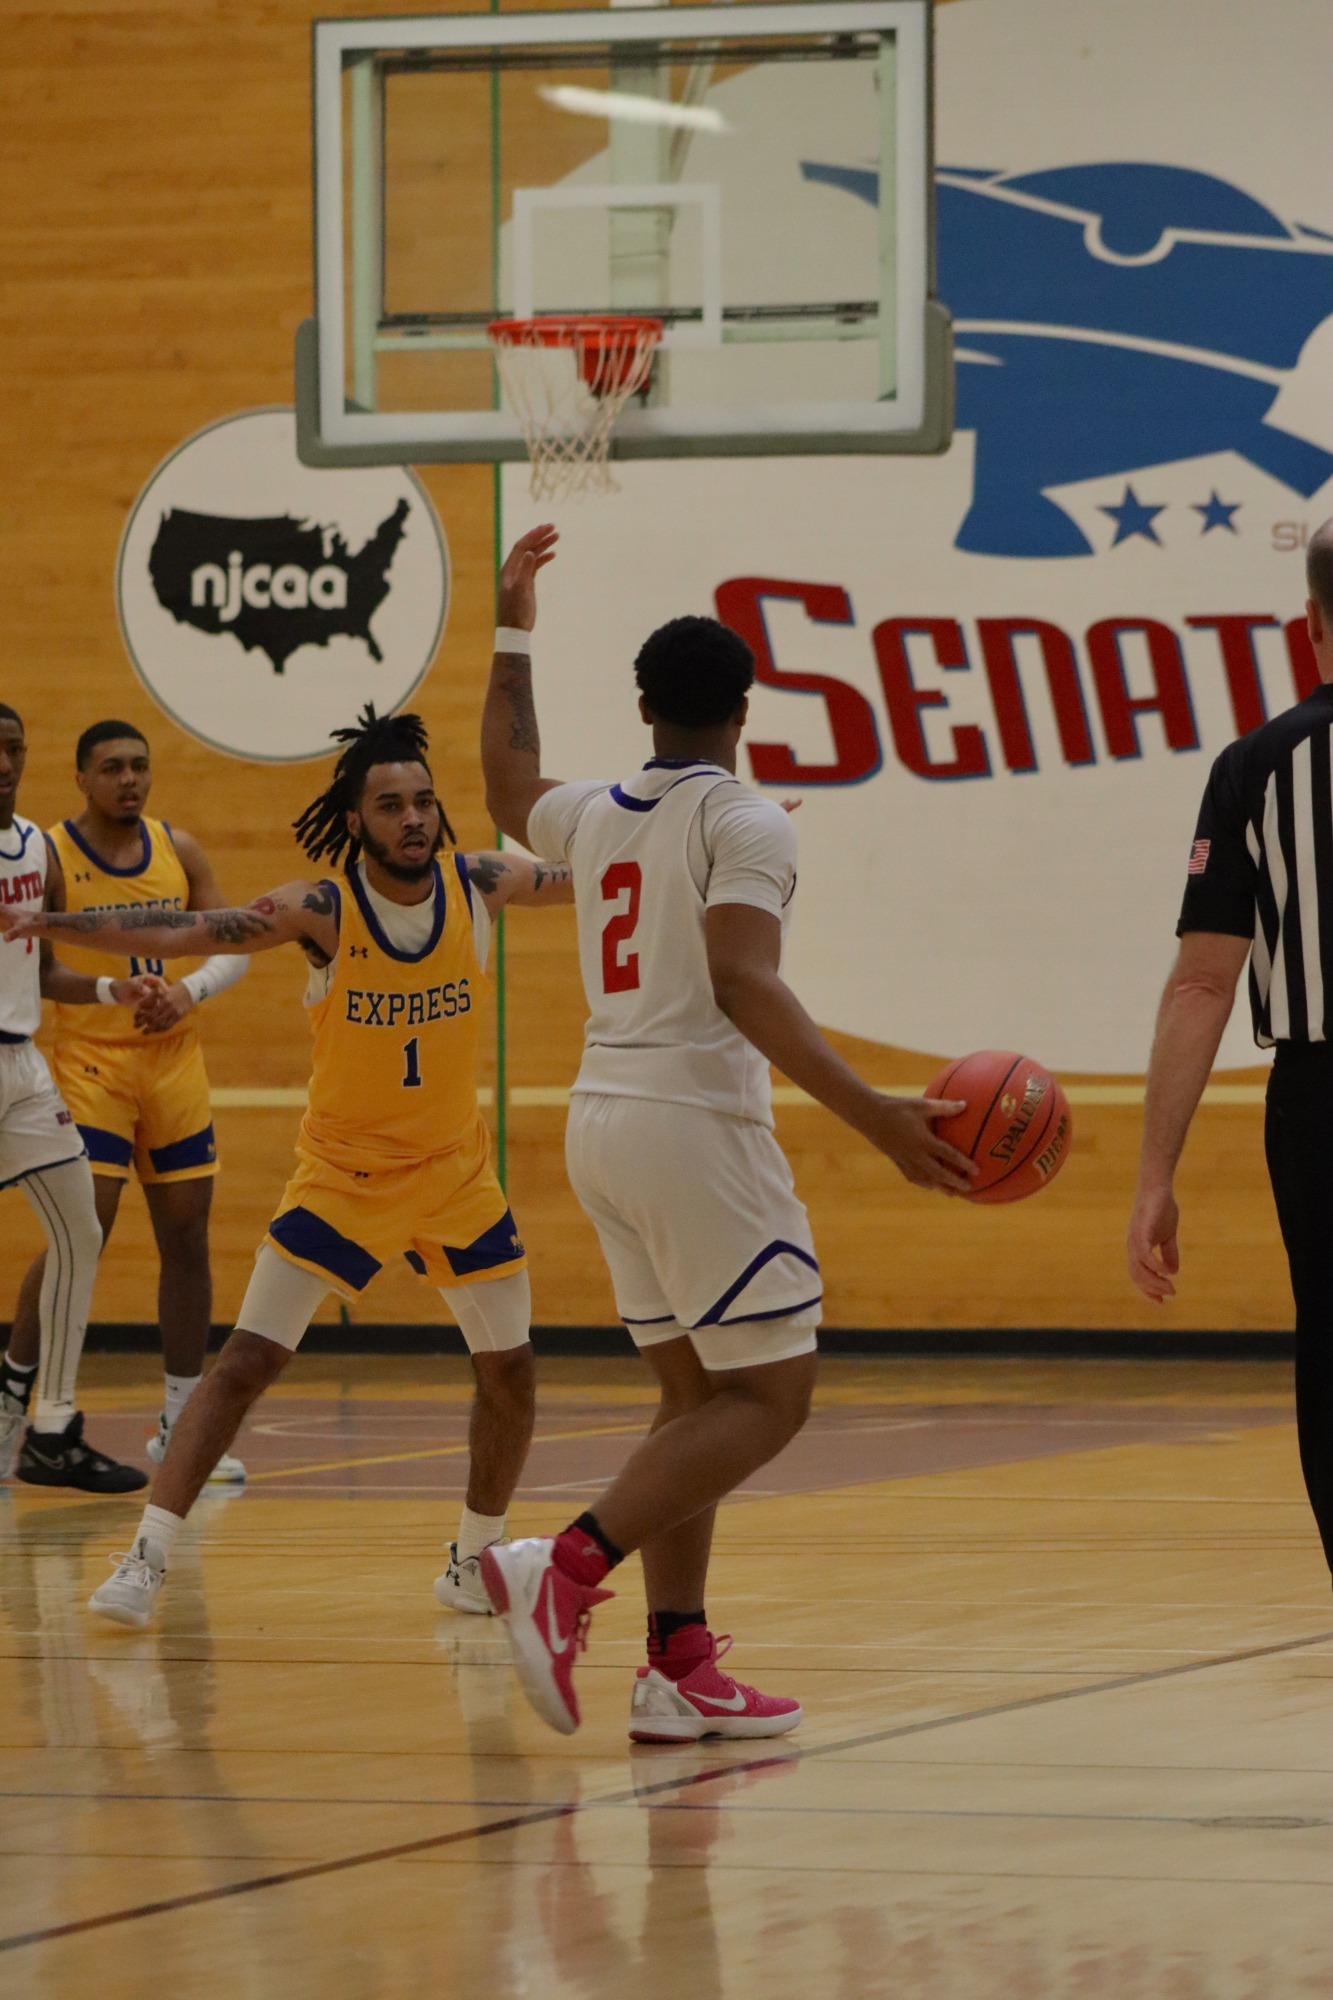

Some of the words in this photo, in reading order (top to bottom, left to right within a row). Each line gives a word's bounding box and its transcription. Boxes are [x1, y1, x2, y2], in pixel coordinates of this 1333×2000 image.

[191, 550, 348, 623] njcaa
[601, 861, 642, 994] 2
[346, 978, 471, 1026] EXPRESS
[403, 1037, 421, 1087] 1
